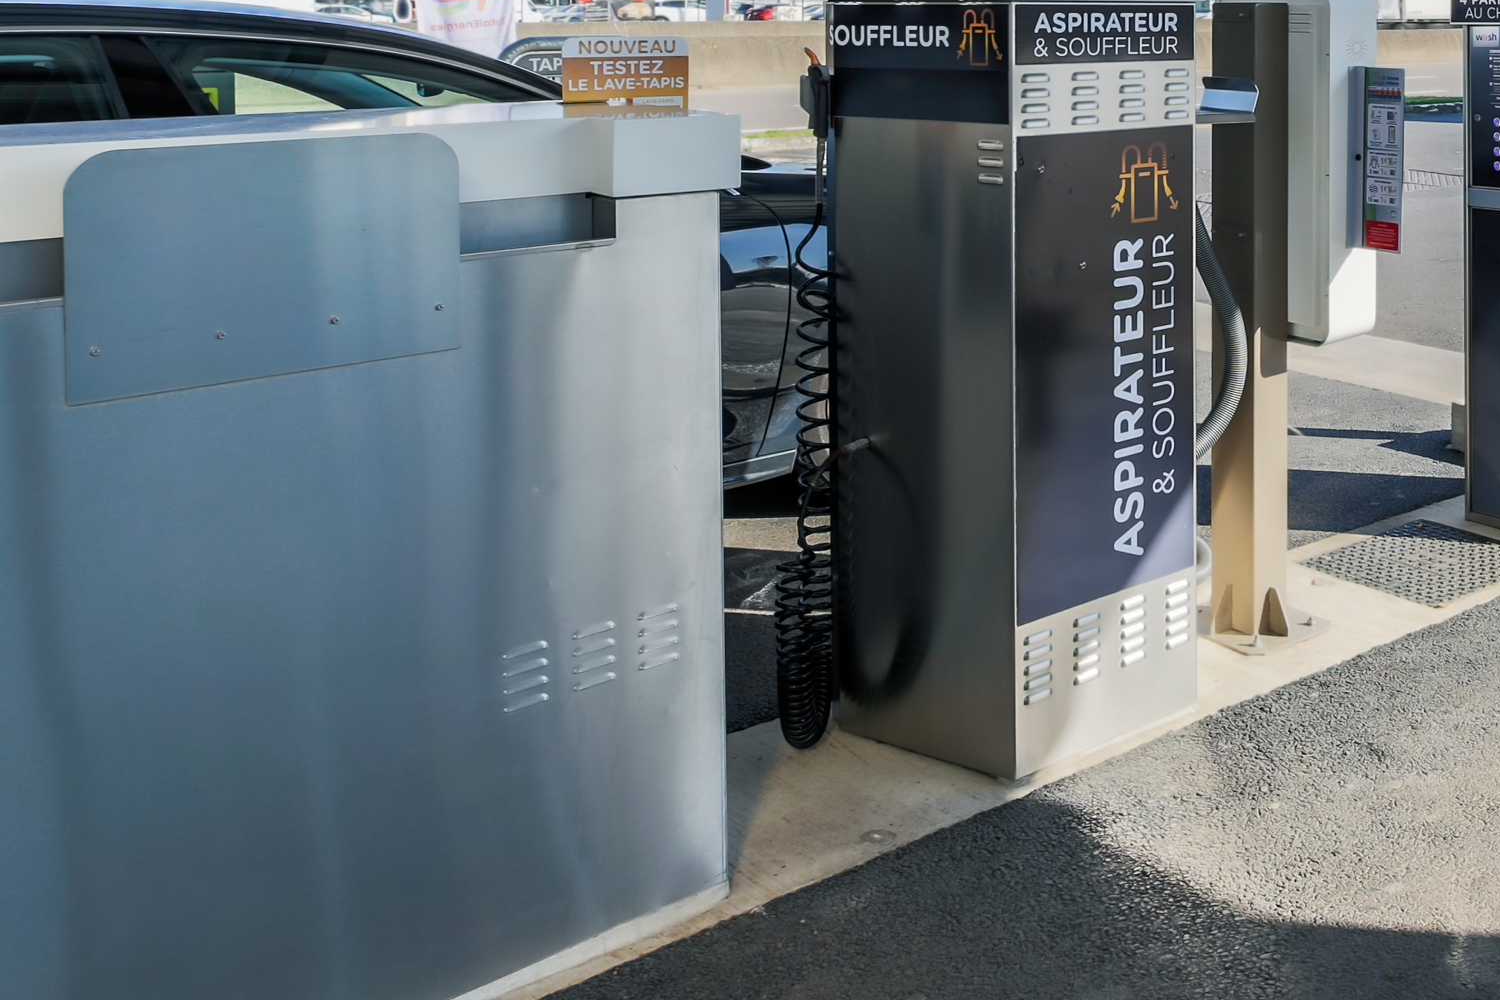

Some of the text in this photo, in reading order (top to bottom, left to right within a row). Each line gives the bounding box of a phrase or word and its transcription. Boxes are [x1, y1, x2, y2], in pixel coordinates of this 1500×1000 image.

[1465, 7, 1484, 19] AU
[1034, 12, 1178, 34] ASPIRATEUR
[829, 24, 950, 47] SOUFFLEUR
[1475, 32, 1498, 41] wash
[578, 40, 677, 54] NOUVEAU
[1034, 35, 1178, 57] & SOUFFLEUR
[590, 60, 664, 75] TESTEZ
[568, 76, 685, 91] LE LAVE-TAPIS
[1152, 232, 1175, 495] & SOUFFLEUR
[1113, 236, 1146, 557] ASPIRATEUR
